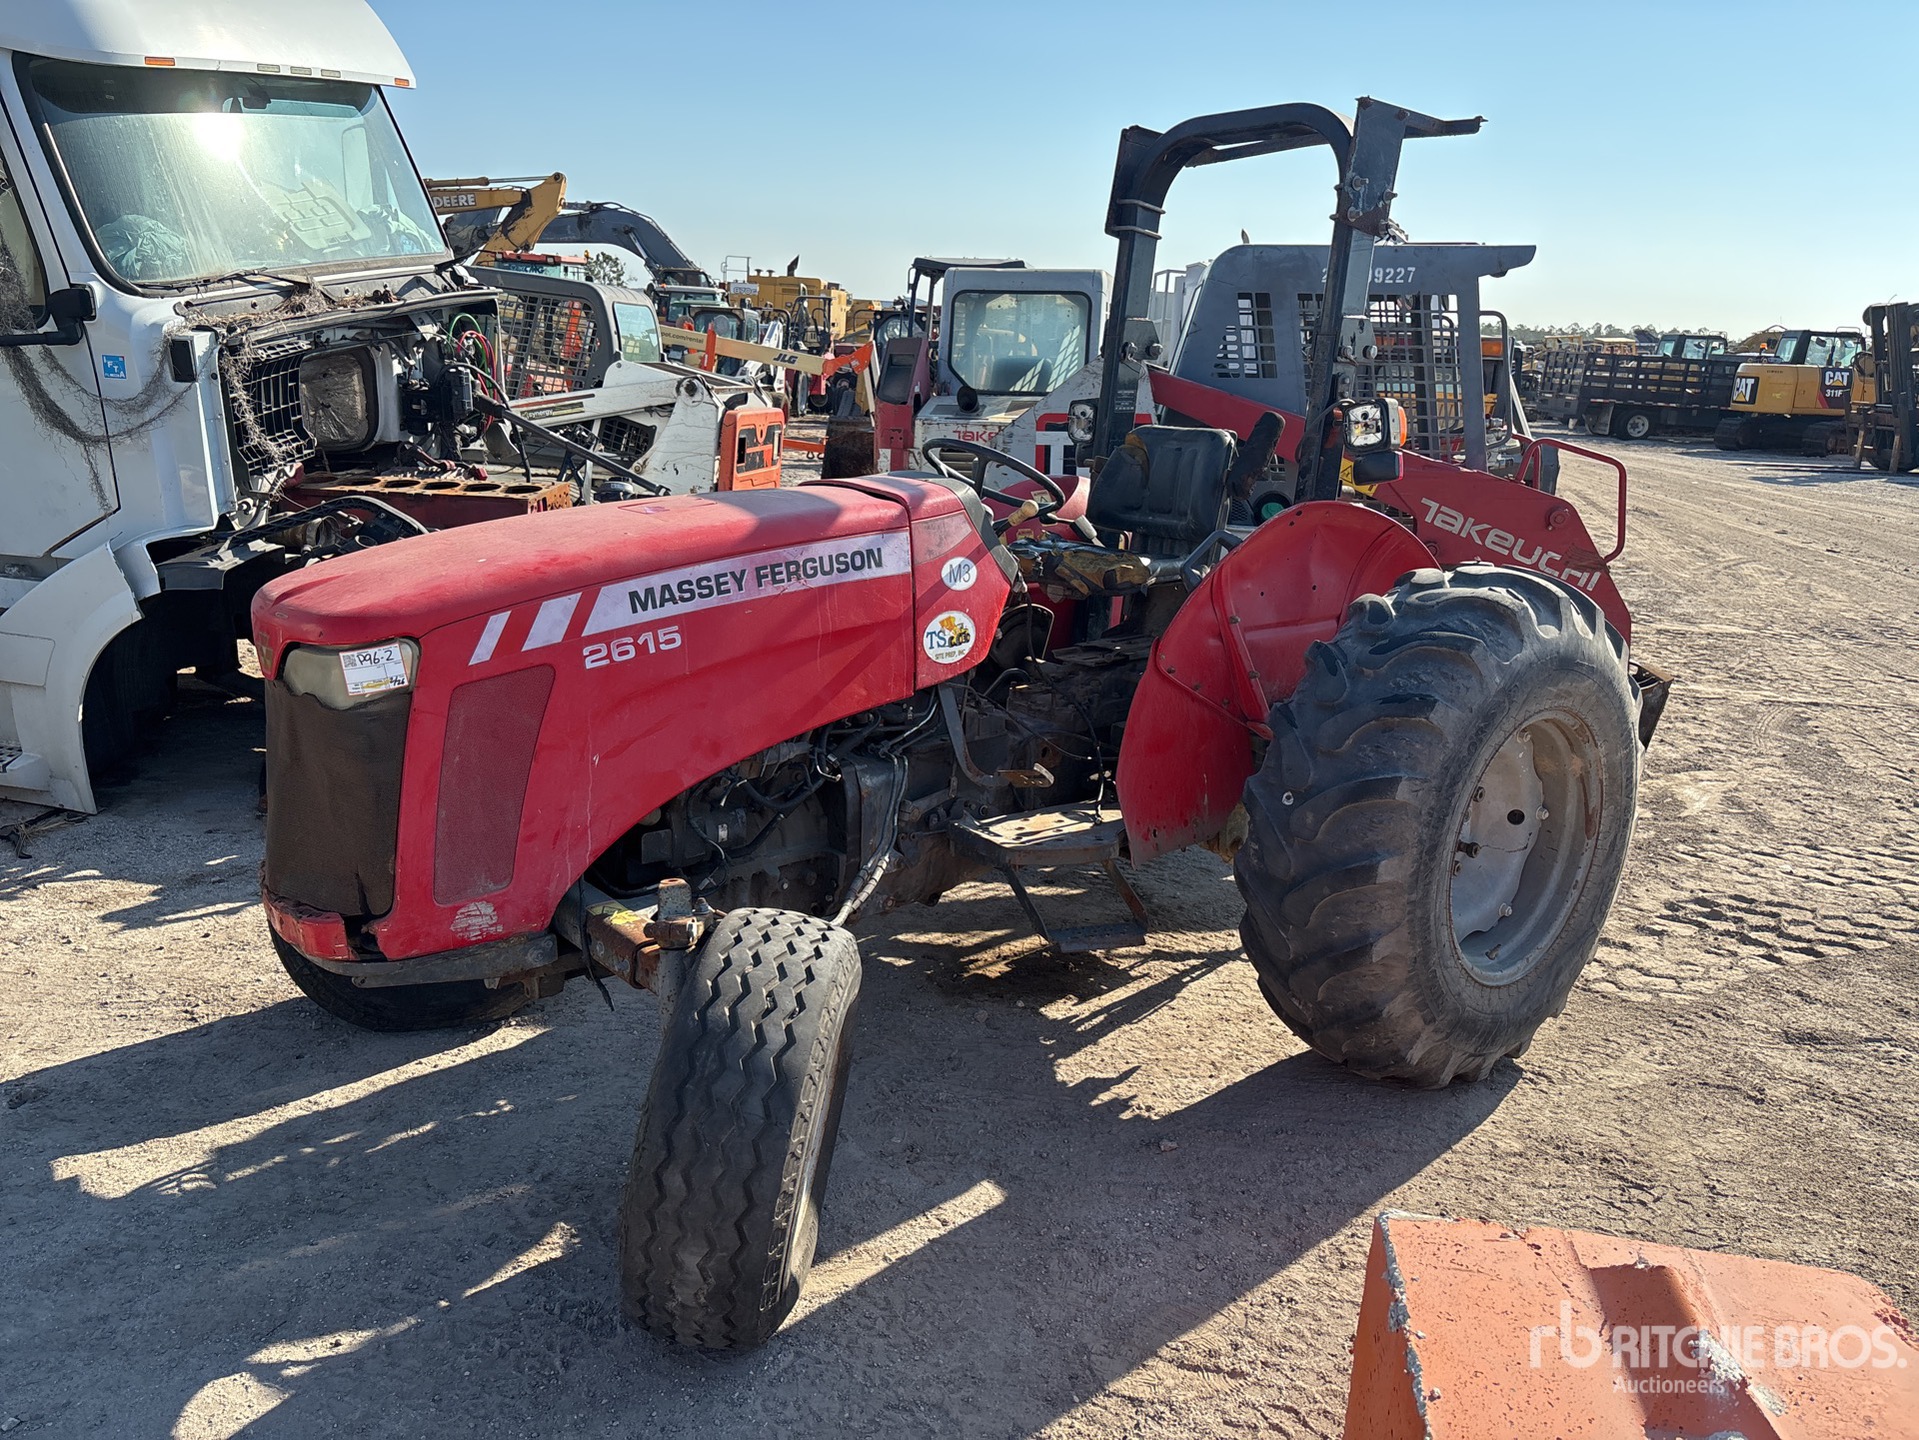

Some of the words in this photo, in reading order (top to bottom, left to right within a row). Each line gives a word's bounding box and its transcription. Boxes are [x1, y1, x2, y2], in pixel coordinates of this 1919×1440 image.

[432, 193, 476, 208] DEERE
[773, 353, 799, 365] JLG
[1825, 371, 1850, 386] CAT
[1732, 377, 1755, 402] CAT
[628, 569, 747, 614] MASSEY
[755, 547, 883, 587] FERGUSON
[949, 563, 971, 583] M3
[582, 625, 682, 669] 2615
[356, 649, 395, 666] P96-2
